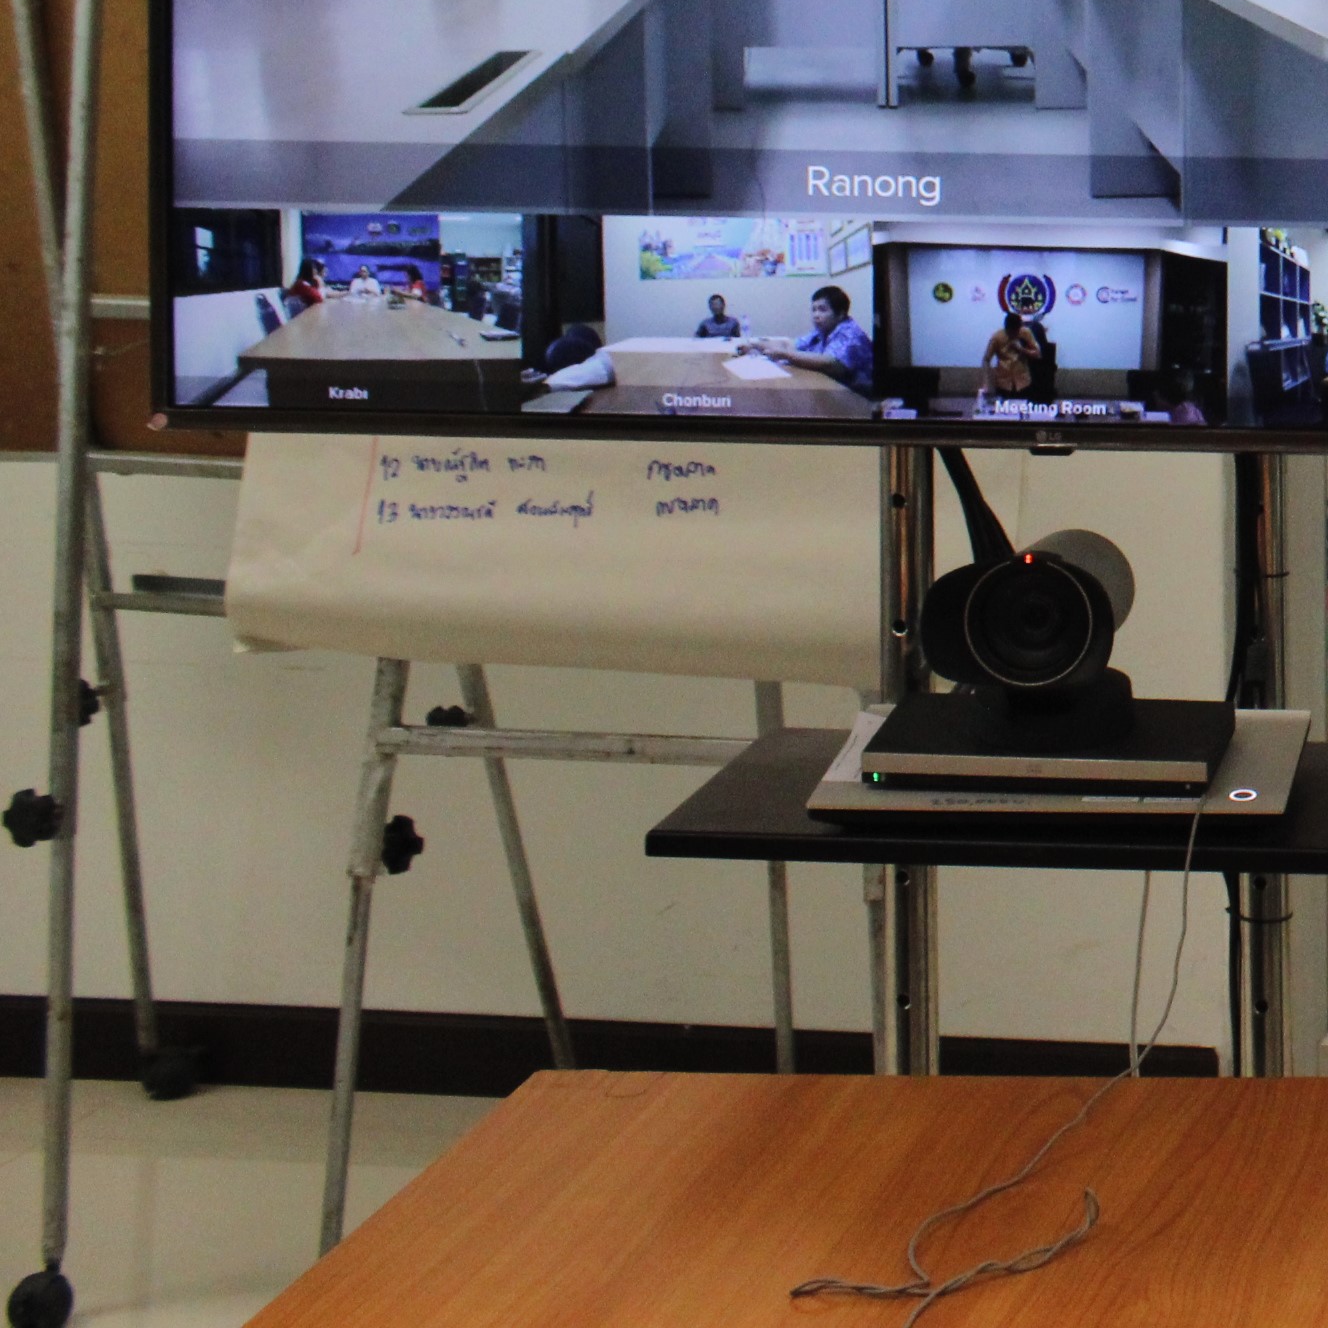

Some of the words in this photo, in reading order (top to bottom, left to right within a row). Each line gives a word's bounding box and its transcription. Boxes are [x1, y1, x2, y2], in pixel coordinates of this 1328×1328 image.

[807, 166, 942, 206] Ranong
[328, 386, 368, 400] Krabi
[662, 393, 731, 408] Chonburi
[995, 401, 1059, 417] Meeting
[1062, 401, 1106, 415] Room
